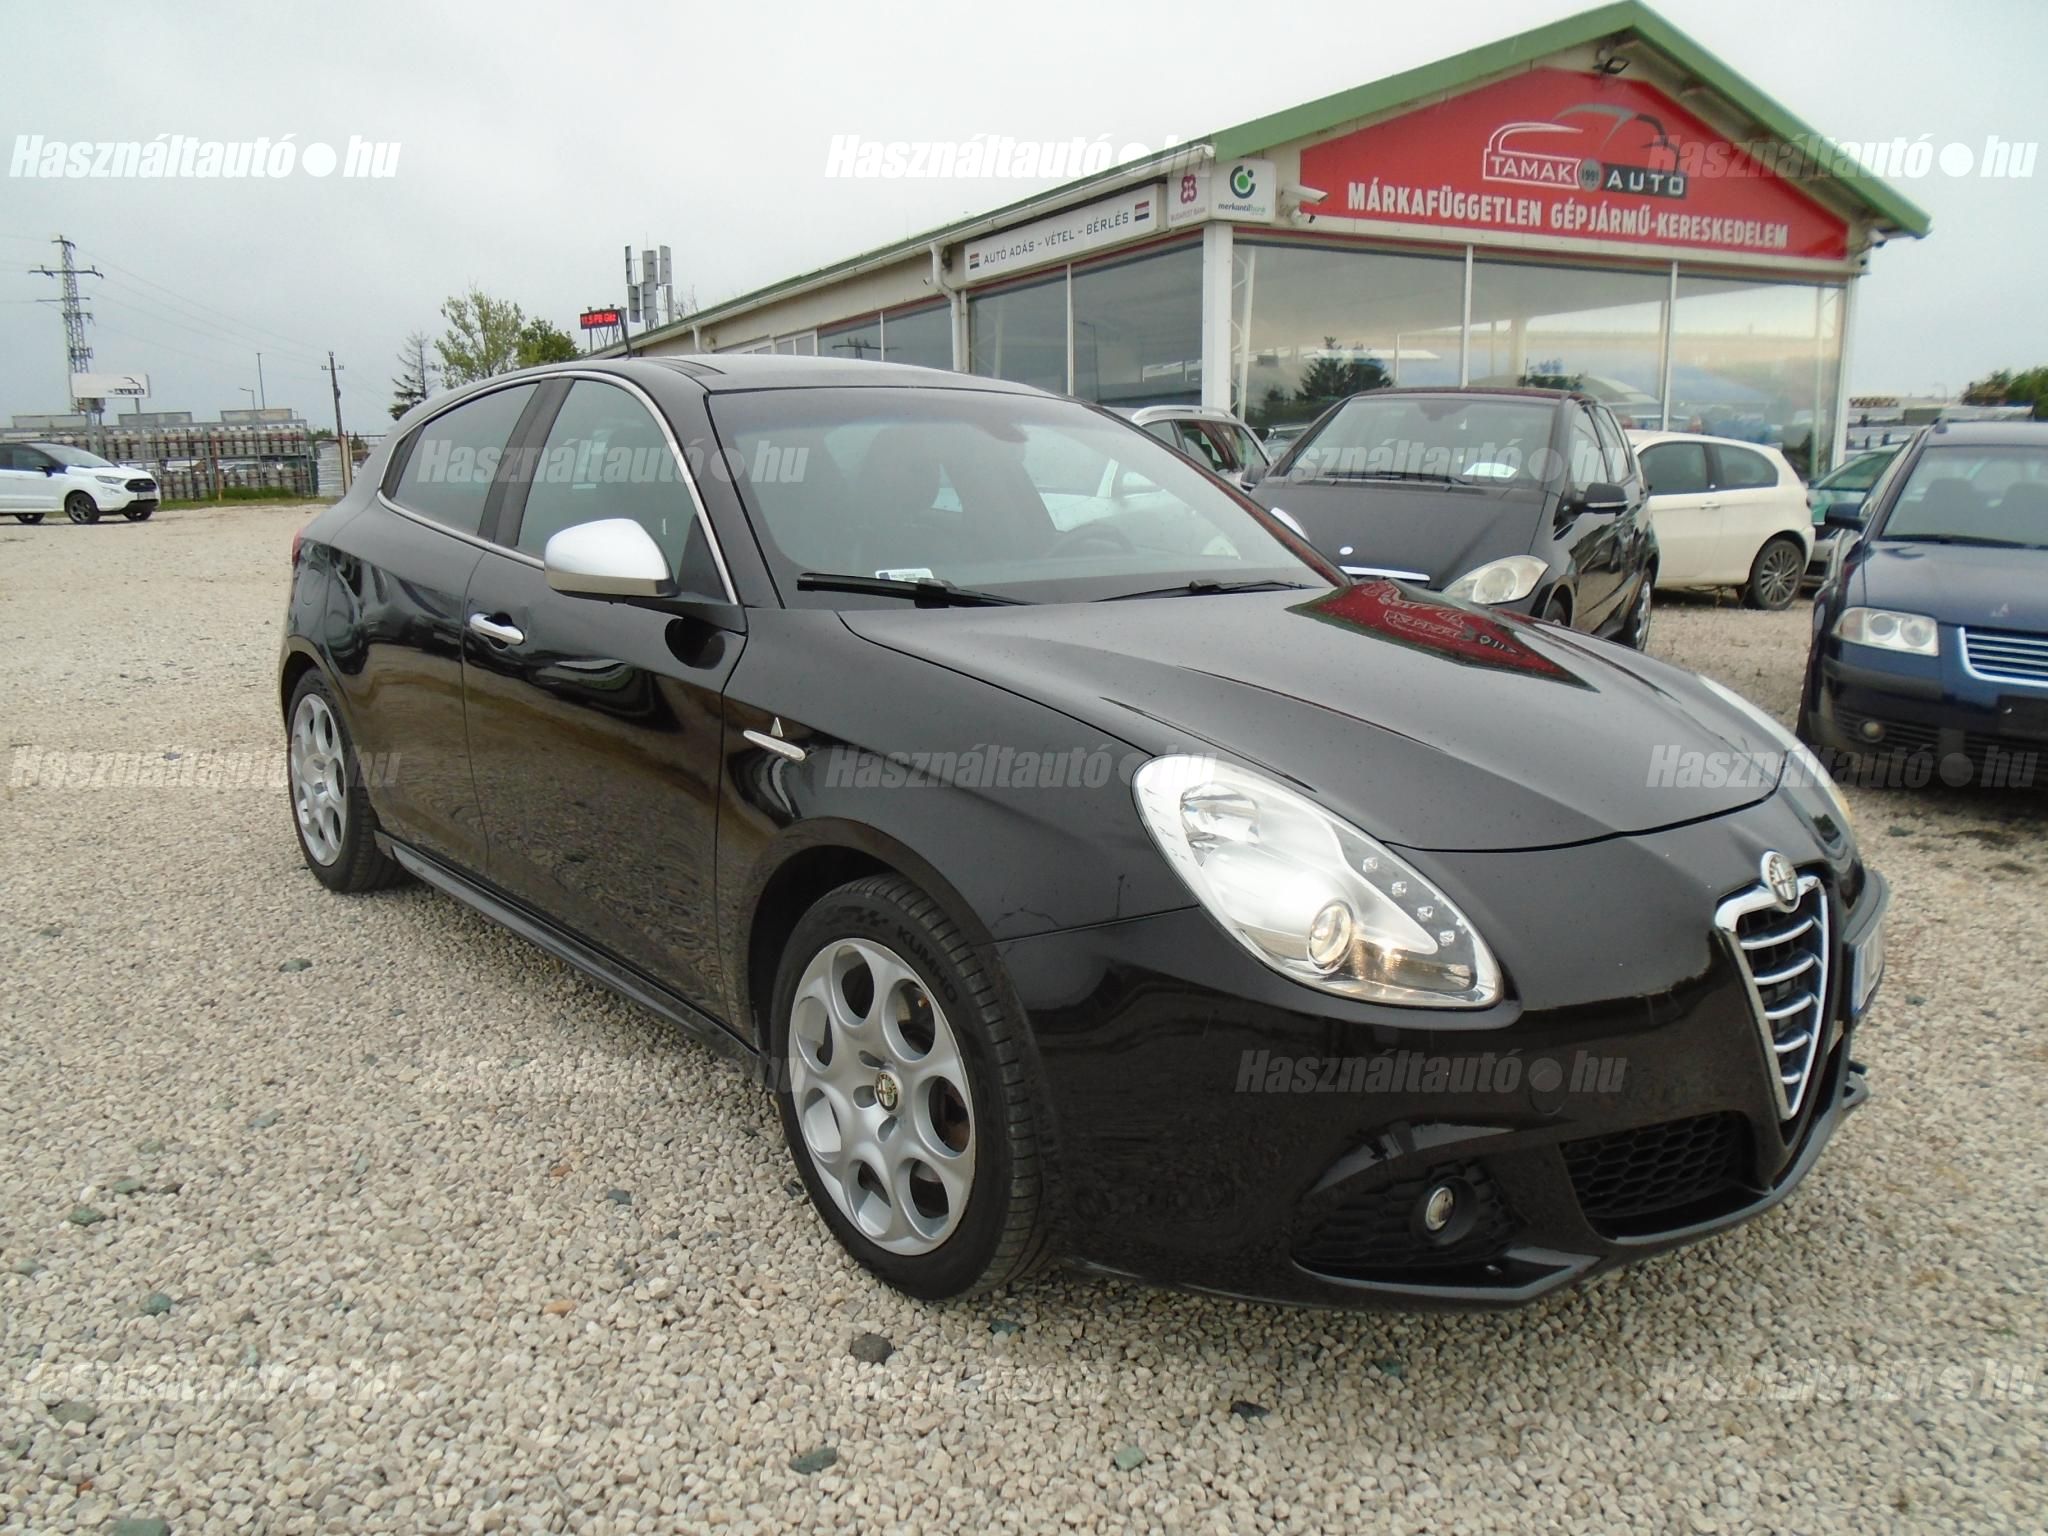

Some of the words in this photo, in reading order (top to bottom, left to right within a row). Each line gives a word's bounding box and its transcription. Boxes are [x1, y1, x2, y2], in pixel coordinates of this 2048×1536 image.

[1491, 156, 1573, 183] TAMAK
[1607, 169, 1684, 195] AUTO
[1347, 177, 1542, 227] MÁRKAFÜGGETLEN
[1009, 239, 1034, 257] ADÁS
[1044, 228, 1075, 247] VÉTEL
[1086, 210, 1129, 236] BÉRLÉS
[898, 925, 958, 1004] KUMHO
